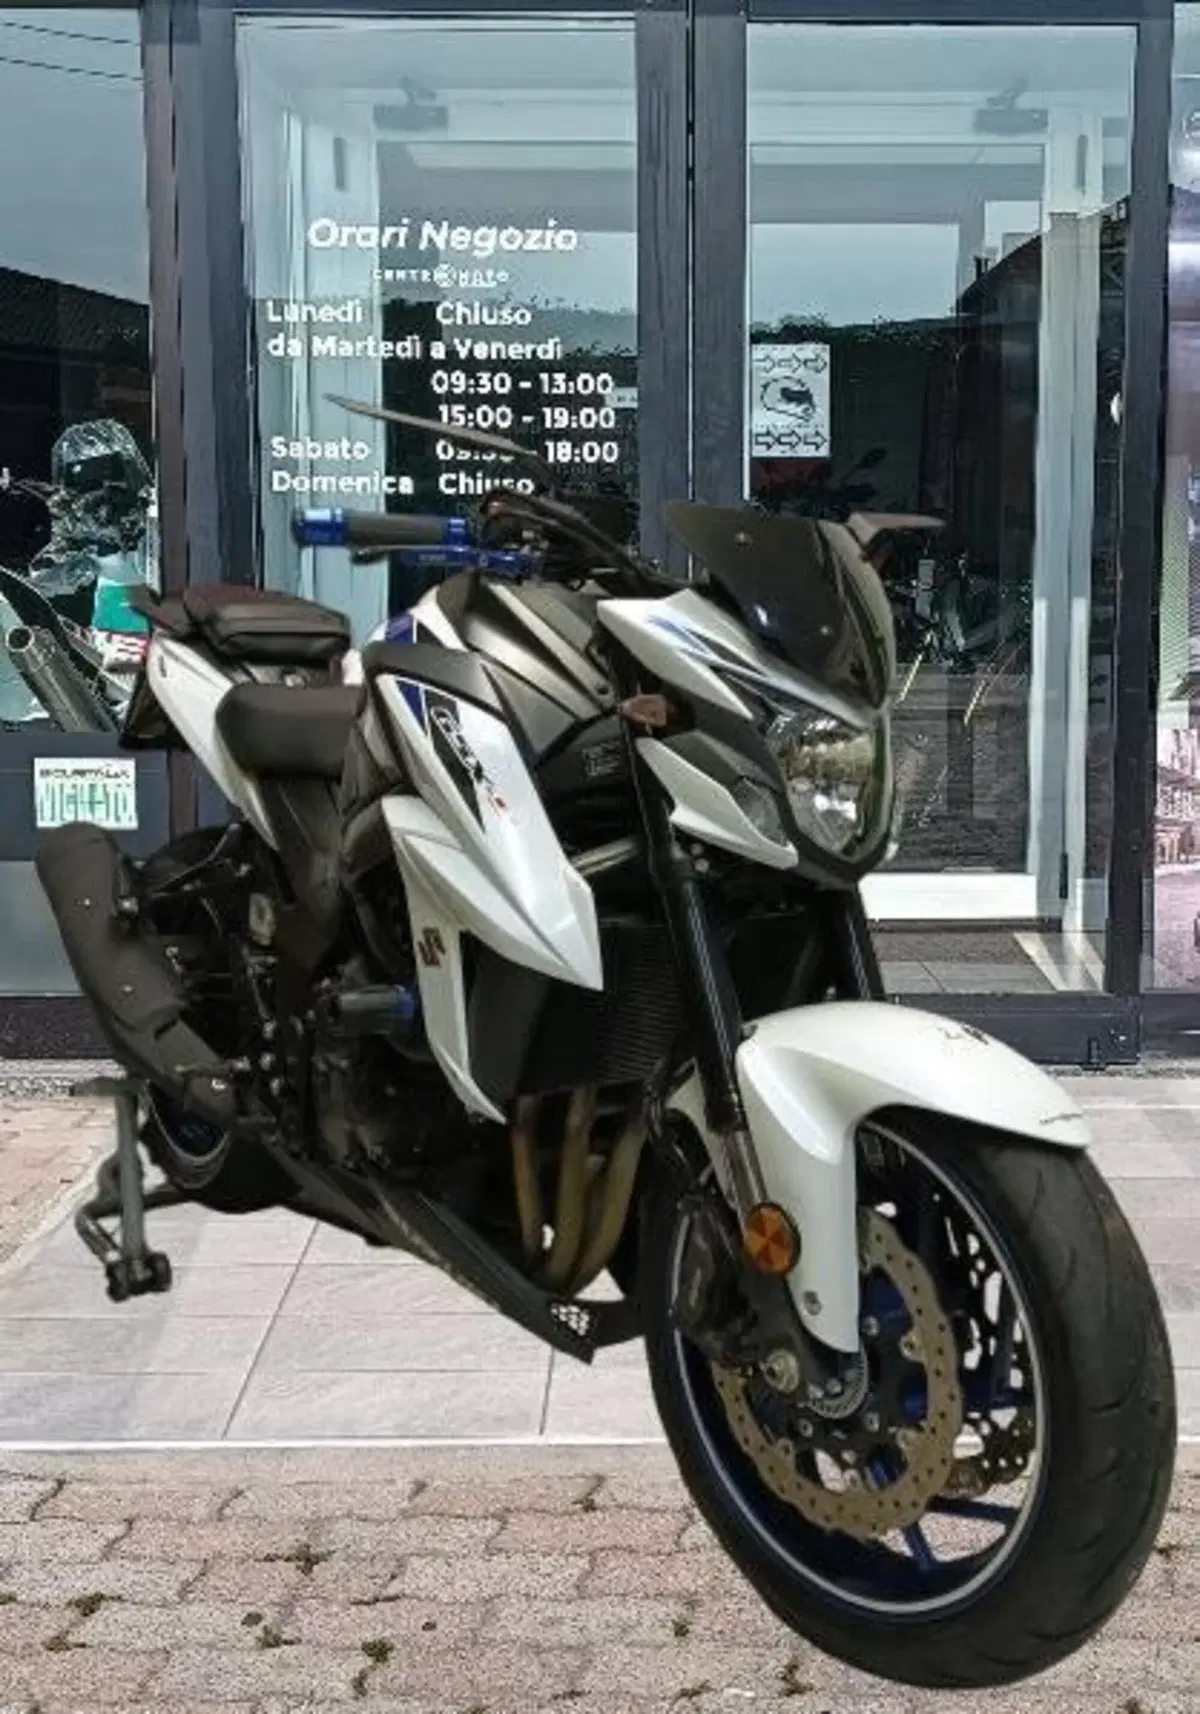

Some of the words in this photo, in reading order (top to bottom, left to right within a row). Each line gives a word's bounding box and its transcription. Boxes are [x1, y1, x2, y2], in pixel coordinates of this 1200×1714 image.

[308, 217, 410, 249] Orari
[419, 218, 578, 258] Negozio
[436, 301, 532, 325] Chiuso
[267, 332, 302, 357] da
[430, 341, 446, 360] a
[431, 370, 512, 394] 09:30
[539, 372, 614, 395] 13:00
[438, 404, 513, 428] 15:00
[542, 407, 615, 429] 19:00
[270, 435, 370, 460] Sabato
[545, 440, 619, 463] 18:00
[271, 470, 414, 495] Domenica
